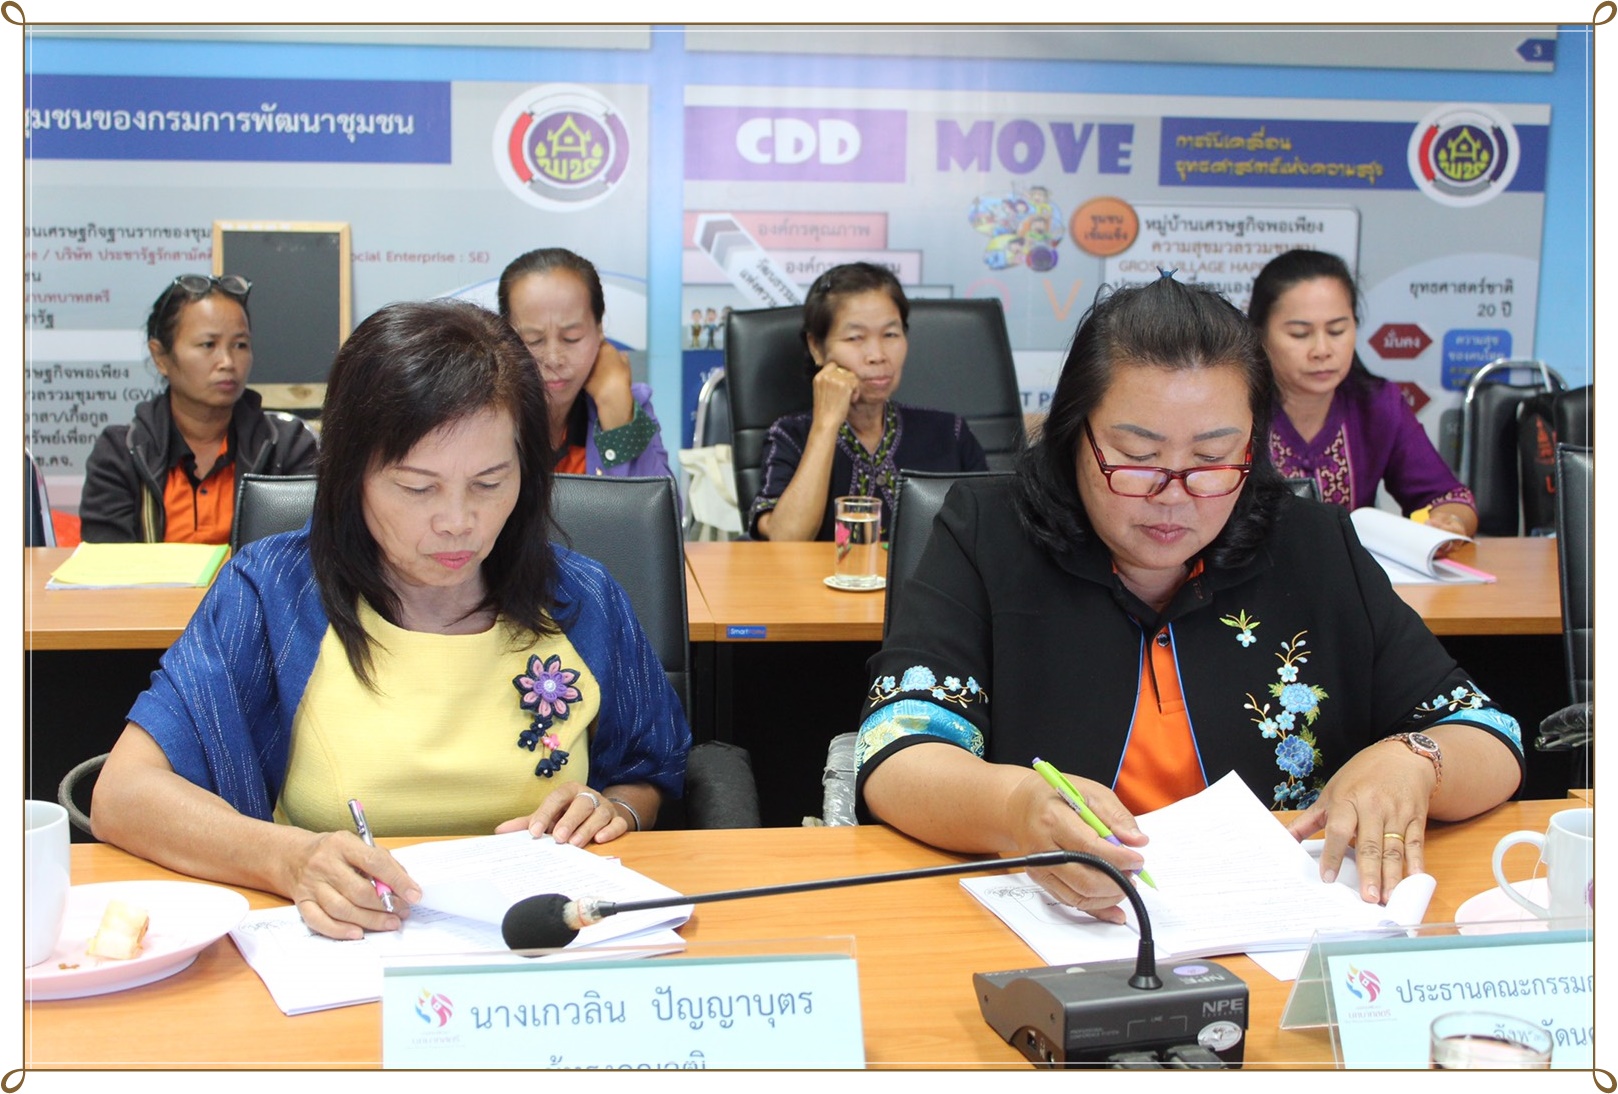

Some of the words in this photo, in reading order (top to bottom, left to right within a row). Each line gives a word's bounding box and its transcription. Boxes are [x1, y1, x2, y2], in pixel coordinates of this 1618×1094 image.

[735, 117, 862, 166] CDD
[935, 118, 1135, 177] MOVE
[350, 251, 381, 263] ocial
[386, 251, 456, 264] Enterprise
[468, 251, 490, 264] SE)
[1169, 260, 1226, 273] VILLAGE
[1409, 278, 1514, 298] ยุทธศาสตร์ชาติ
[1476, 307, 1497, 318] 20
[1501, 301, 1513, 318] ปี
[470, 990, 626, 1029] นางเกวลิน
[651, 985, 813, 1030] ปัญญาบุตร
[1202, 997, 1245, 1014] NPE
